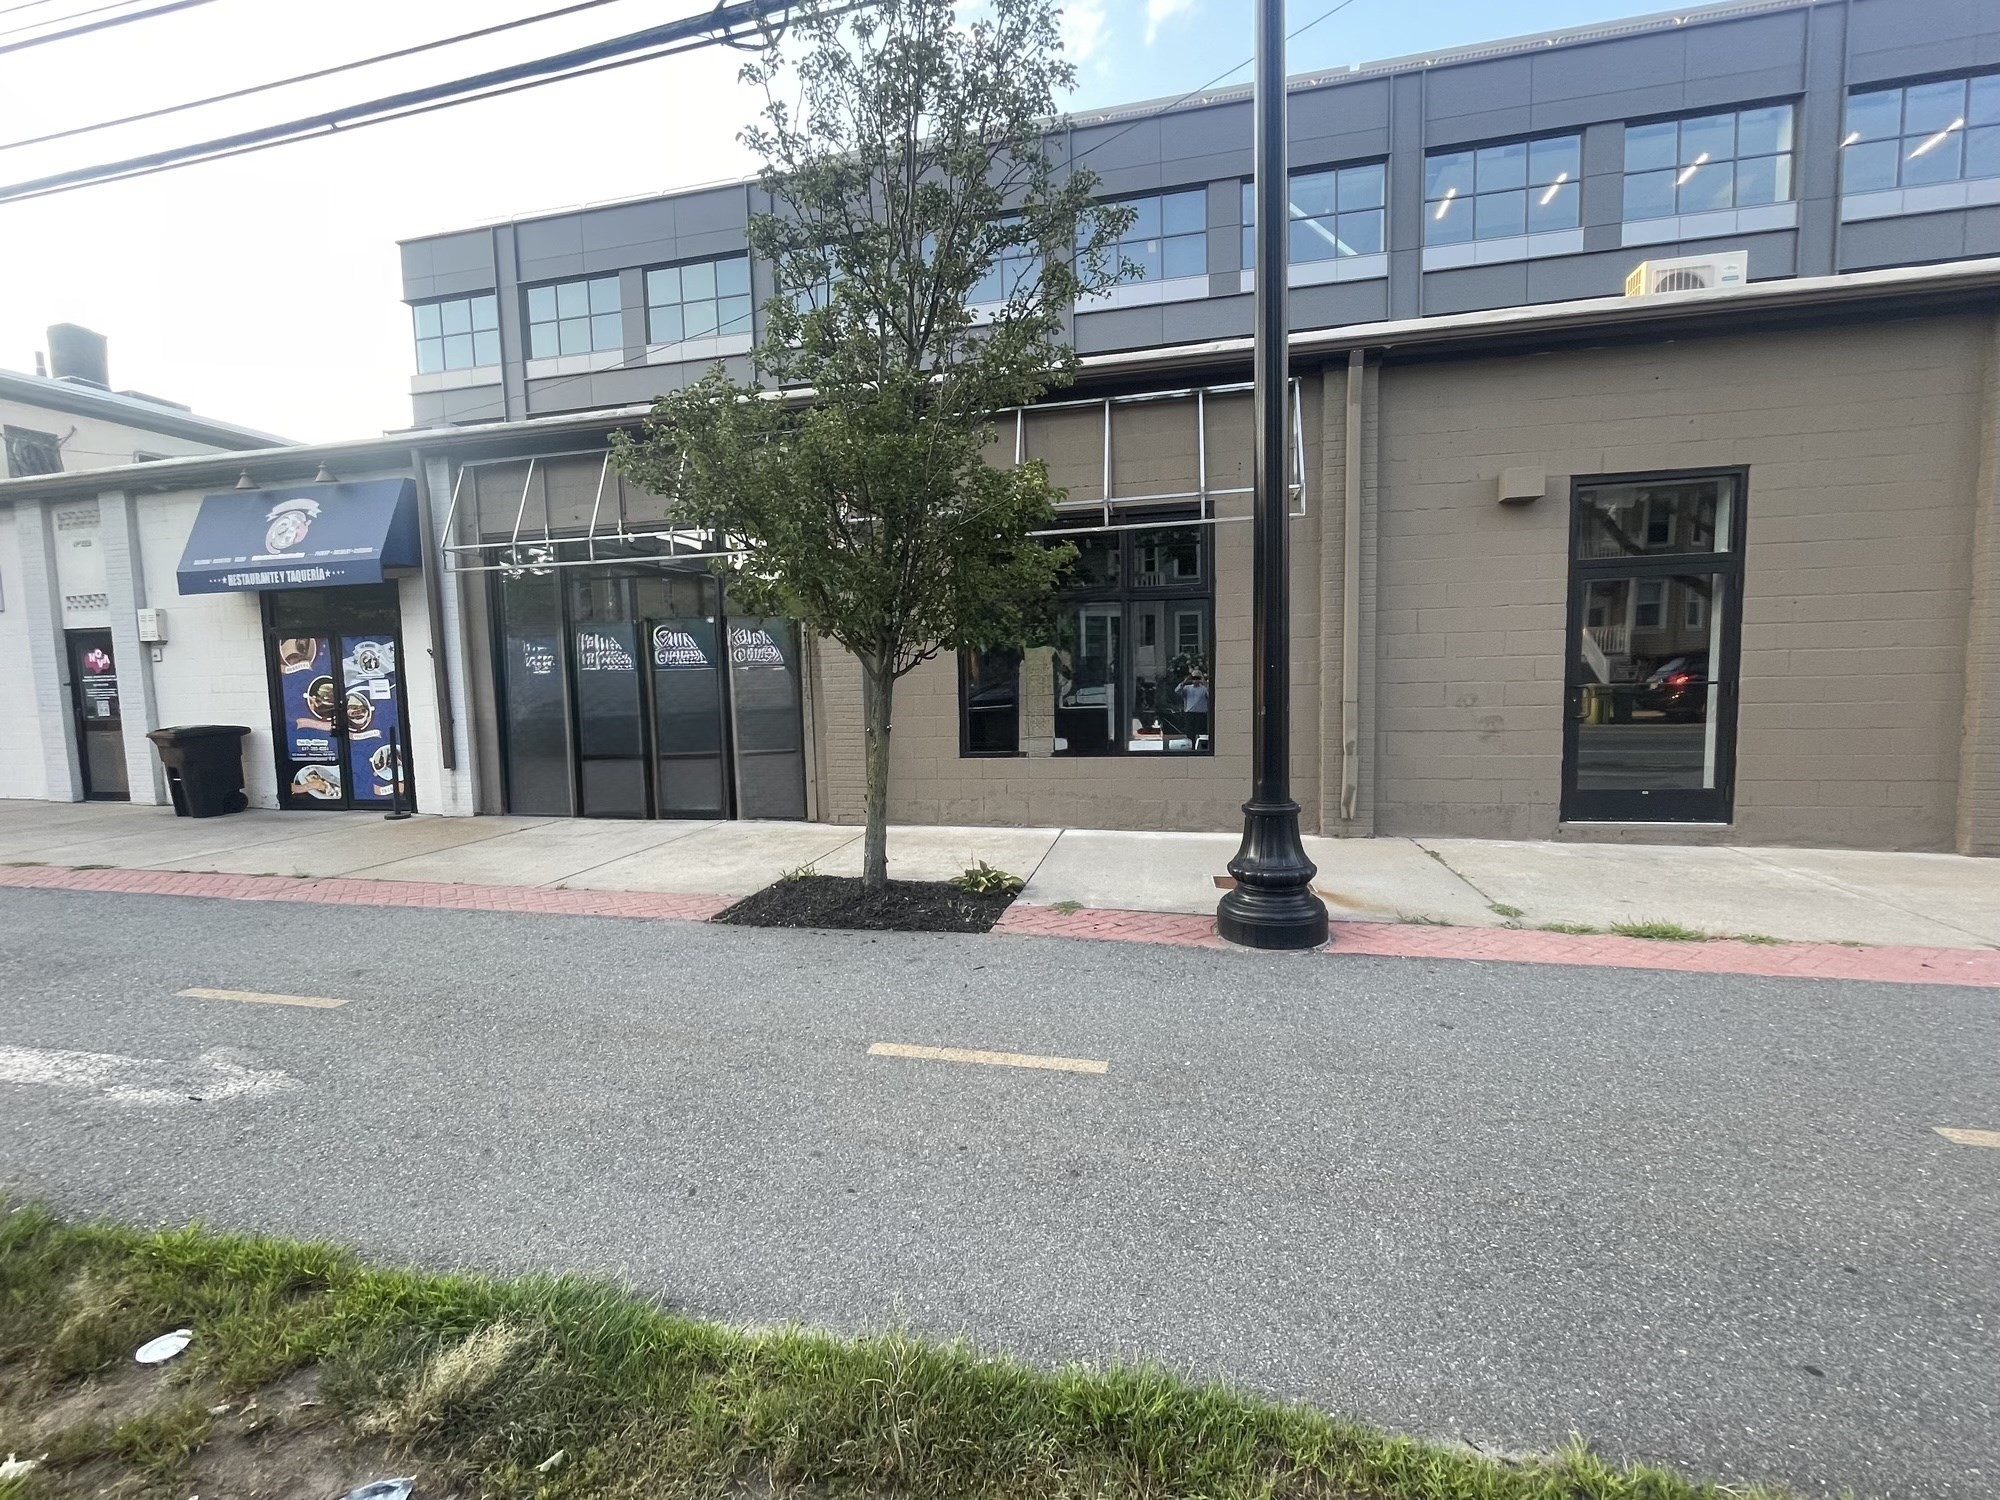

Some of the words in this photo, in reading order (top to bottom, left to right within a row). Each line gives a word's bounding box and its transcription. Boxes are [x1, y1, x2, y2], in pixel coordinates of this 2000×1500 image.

[227, 571, 280, 587] RESTAURANTE
[279, 571, 285, 583] Y
[285, 566, 325, 583] TAQUERÍA
[88, 648, 110, 668] NOVA
